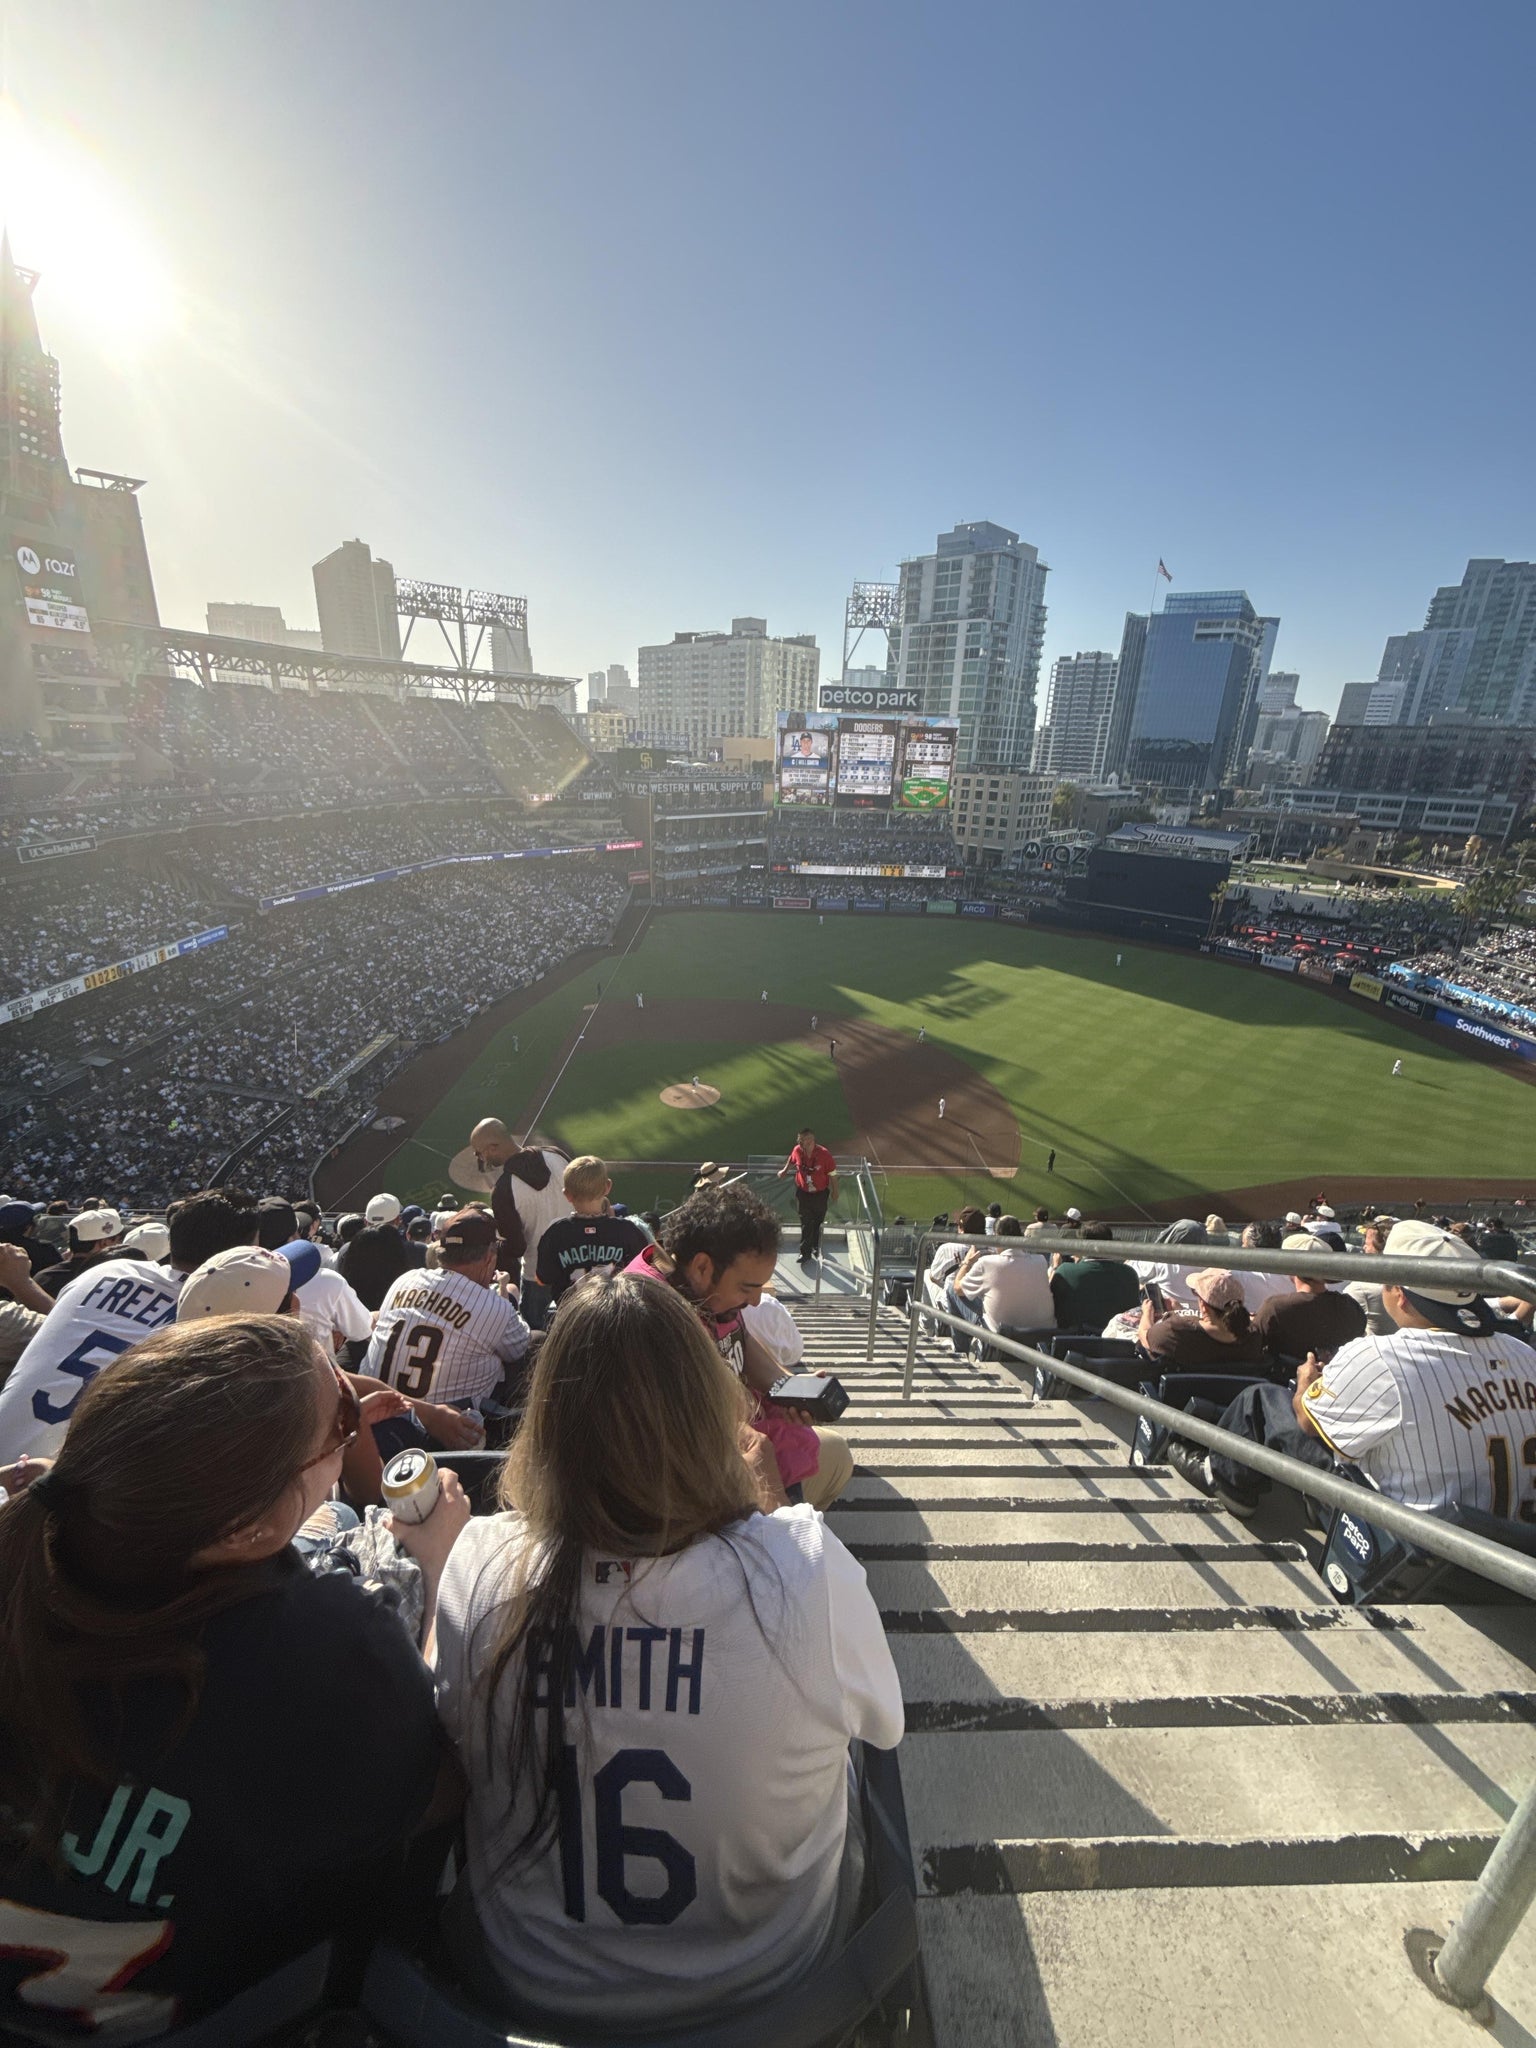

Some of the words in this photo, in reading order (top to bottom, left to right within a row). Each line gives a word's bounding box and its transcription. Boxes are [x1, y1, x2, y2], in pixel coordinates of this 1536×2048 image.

[45, 558, 75, 576] razr
[821, 687, 873, 706] petco
[876, 691, 918, 709] park
[854, 722, 883, 733] DODGERS
[650, 782, 690, 793] WESTERN
[693, 782, 720, 792] METAL
[720, 782, 749, 792] SUPPLY
[1134, 823, 1195, 848] Sycuan
[963, 905, 986, 913] ARCO
[1456, 1018, 1512, 1049] Southwest
[558, 1244, 624, 1268] MACHADO
[391, 1289, 472, 1330] MACHADO
[379, 1318, 445, 1399] 13
[1341, 1512, 1370, 1550] petco
[1343, 1527, 1367, 1560] park
[1333, 1571, 1343, 1585] 15
[61, 1785, 191, 1907] JR.
[555, 1745, 697, 1925] 16
